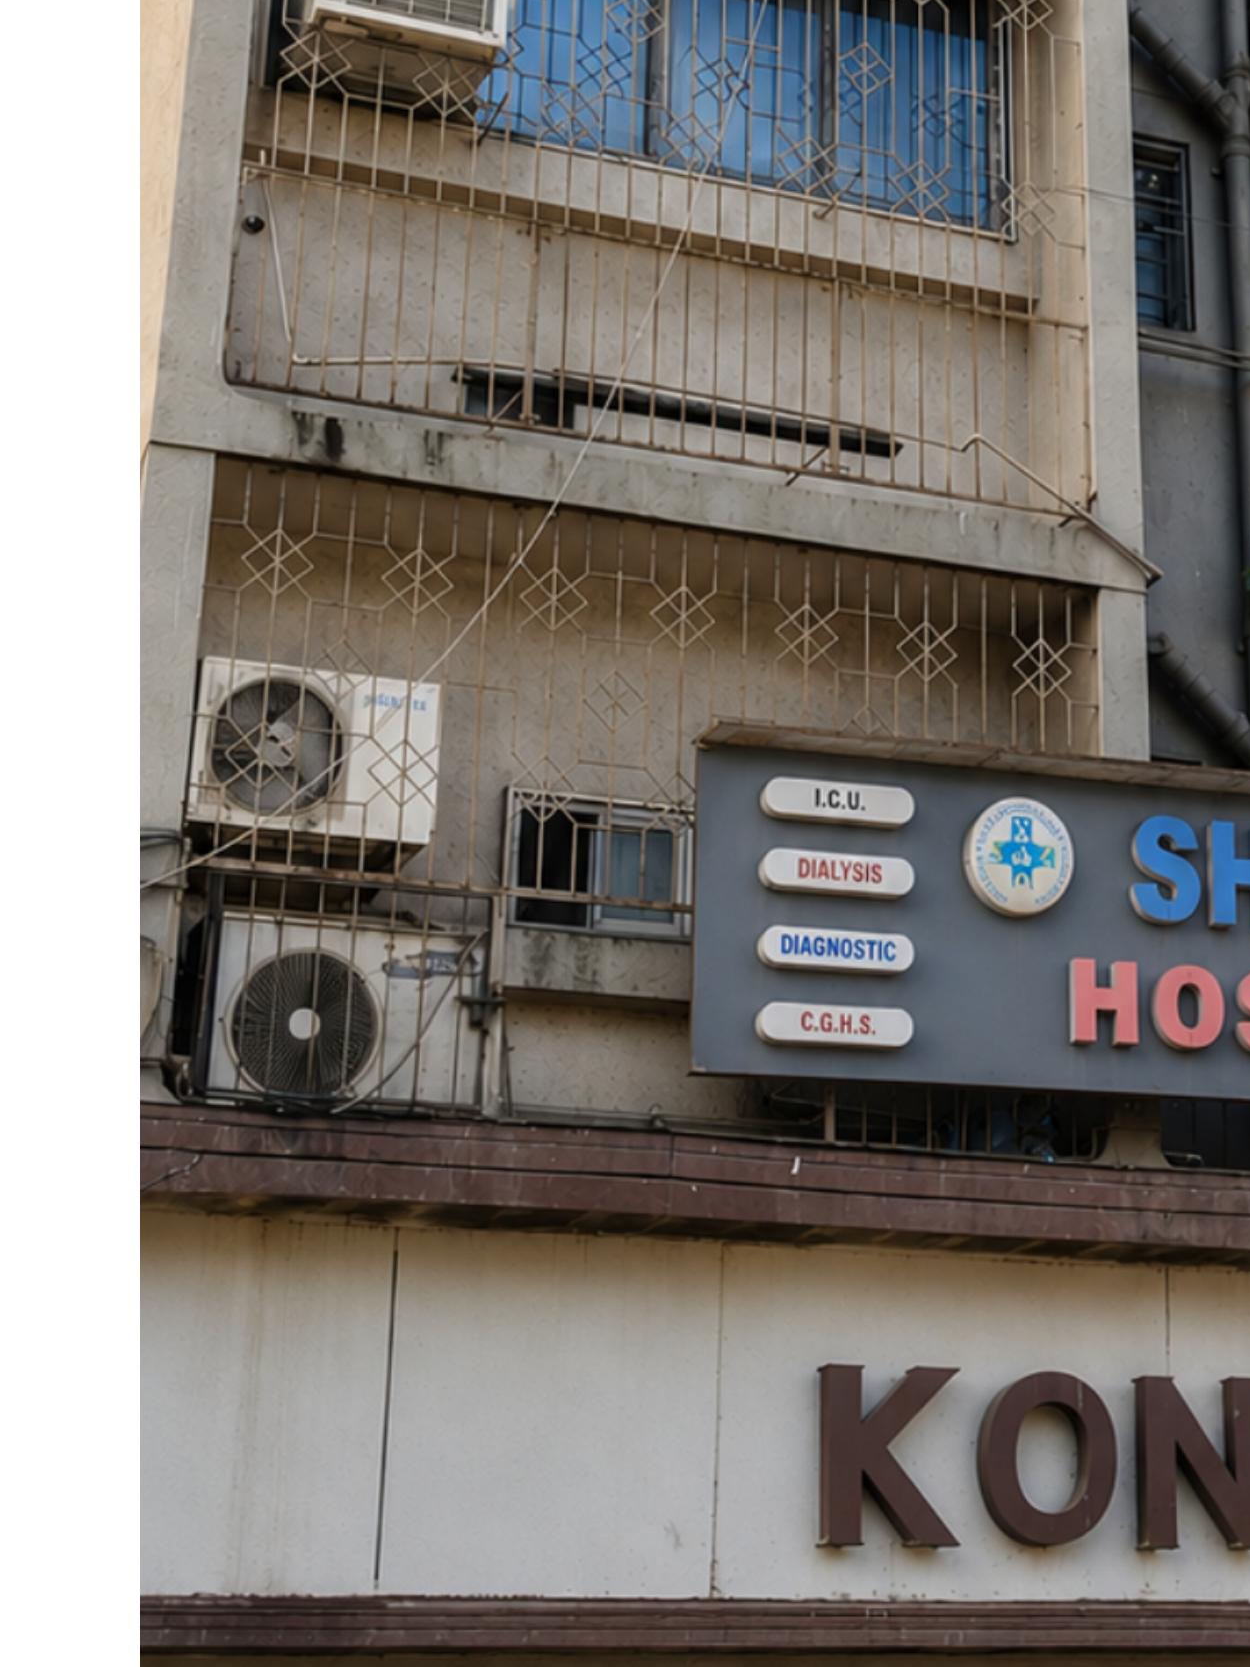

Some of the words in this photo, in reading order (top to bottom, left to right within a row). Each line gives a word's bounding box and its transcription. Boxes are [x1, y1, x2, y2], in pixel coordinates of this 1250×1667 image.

[814, 787, 866, 811] I.C.U.
[797, 857, 883, 884] DIALYSIS
[780, 934, 897, 962] DIAGNOSTIC
[801, 1011, 876, 1035] C.G.H.S.
